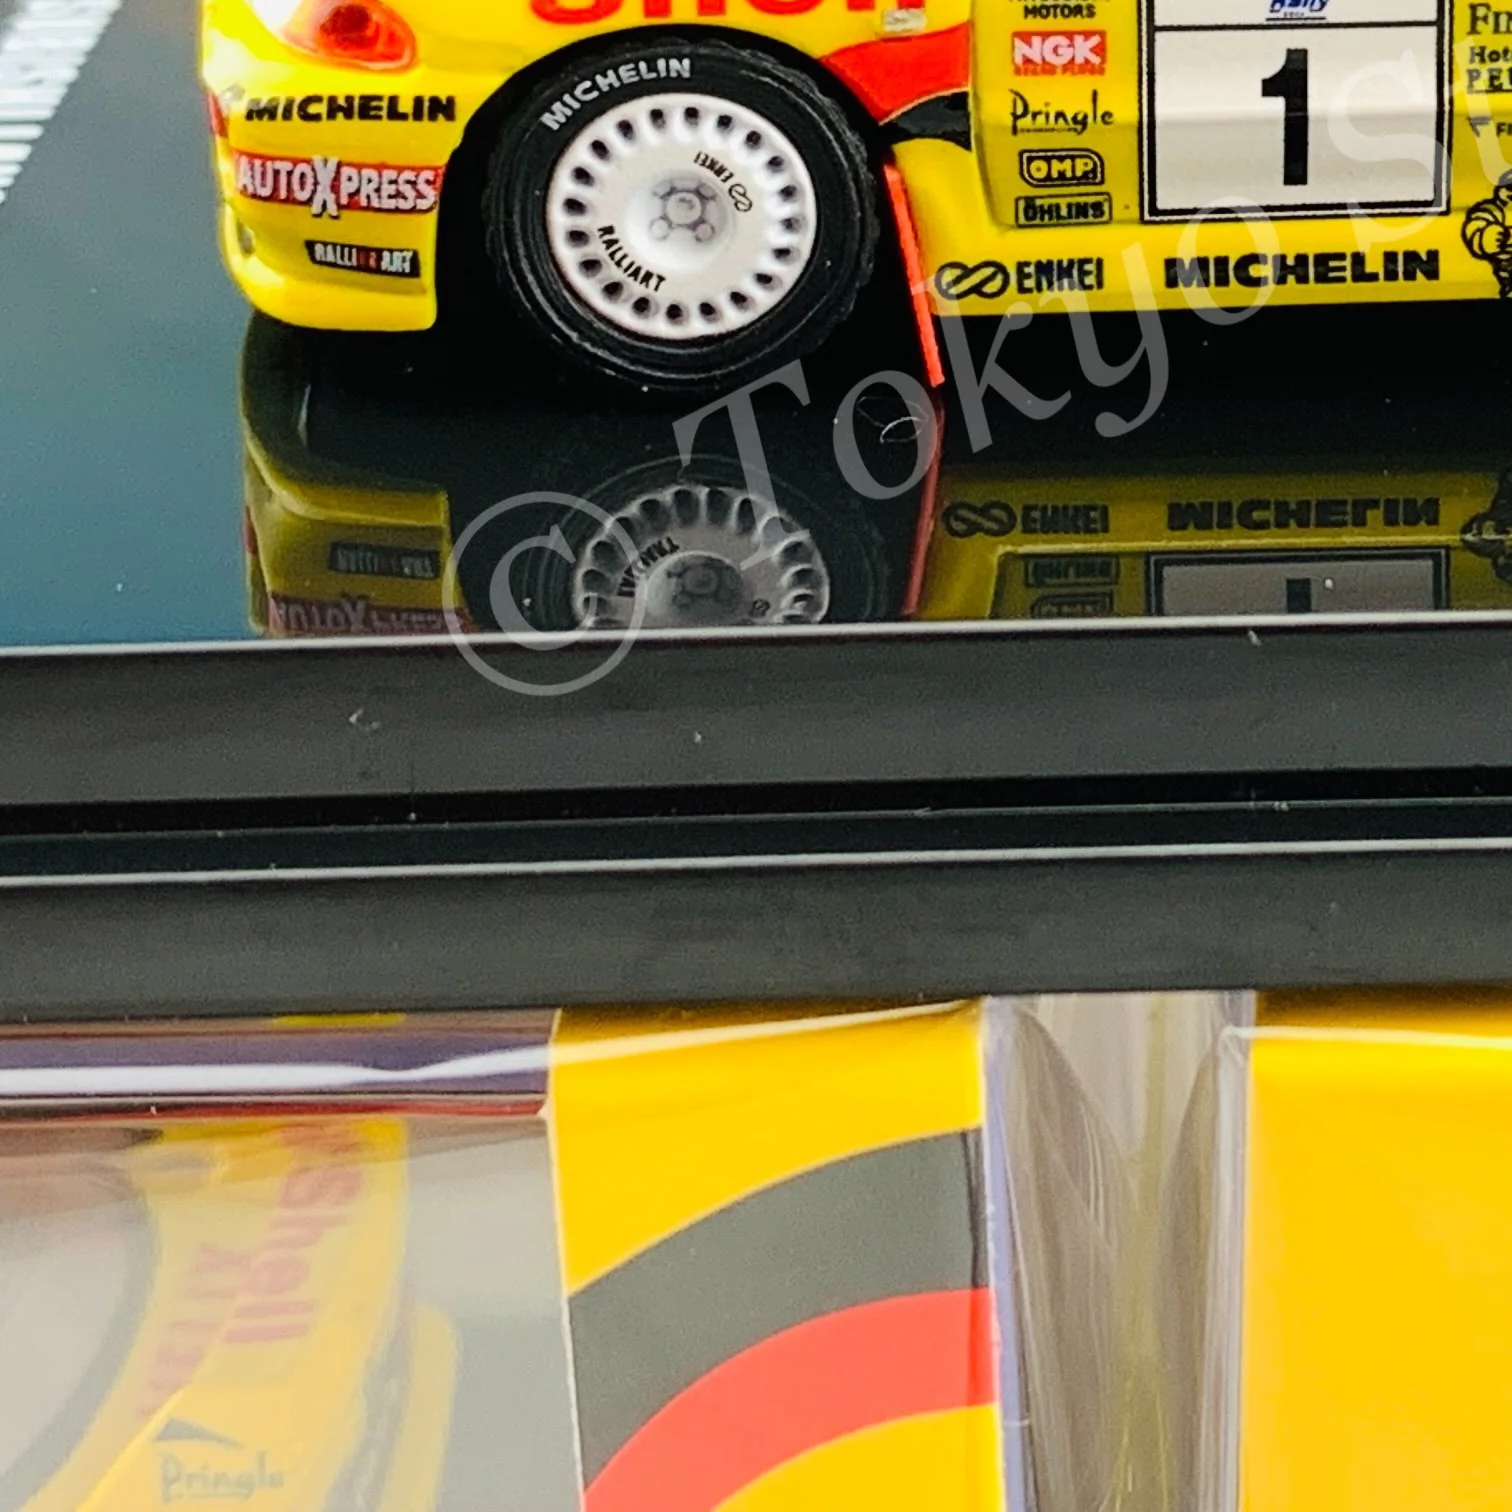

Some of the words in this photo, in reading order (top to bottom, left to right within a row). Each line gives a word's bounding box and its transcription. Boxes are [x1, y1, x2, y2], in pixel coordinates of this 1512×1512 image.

[1023, 3, 1097, 19] MOTORS
[1013, 33, 1103, 66] NGK
[245, 94, 456, 122] MICHELIN
[540, 58, 692, 131] MICHELIN
[1008, 88, 1114, 137] Pringle
[1261, 47, 1309, 186] 1
[237, 154, 437, 219] AUTOXPRESS
[597, 224, 667, 292] RALLIART
[1015, 256, 1104, 295] ENKEI
[1163, 248, 1440, 289] MICHELIN
